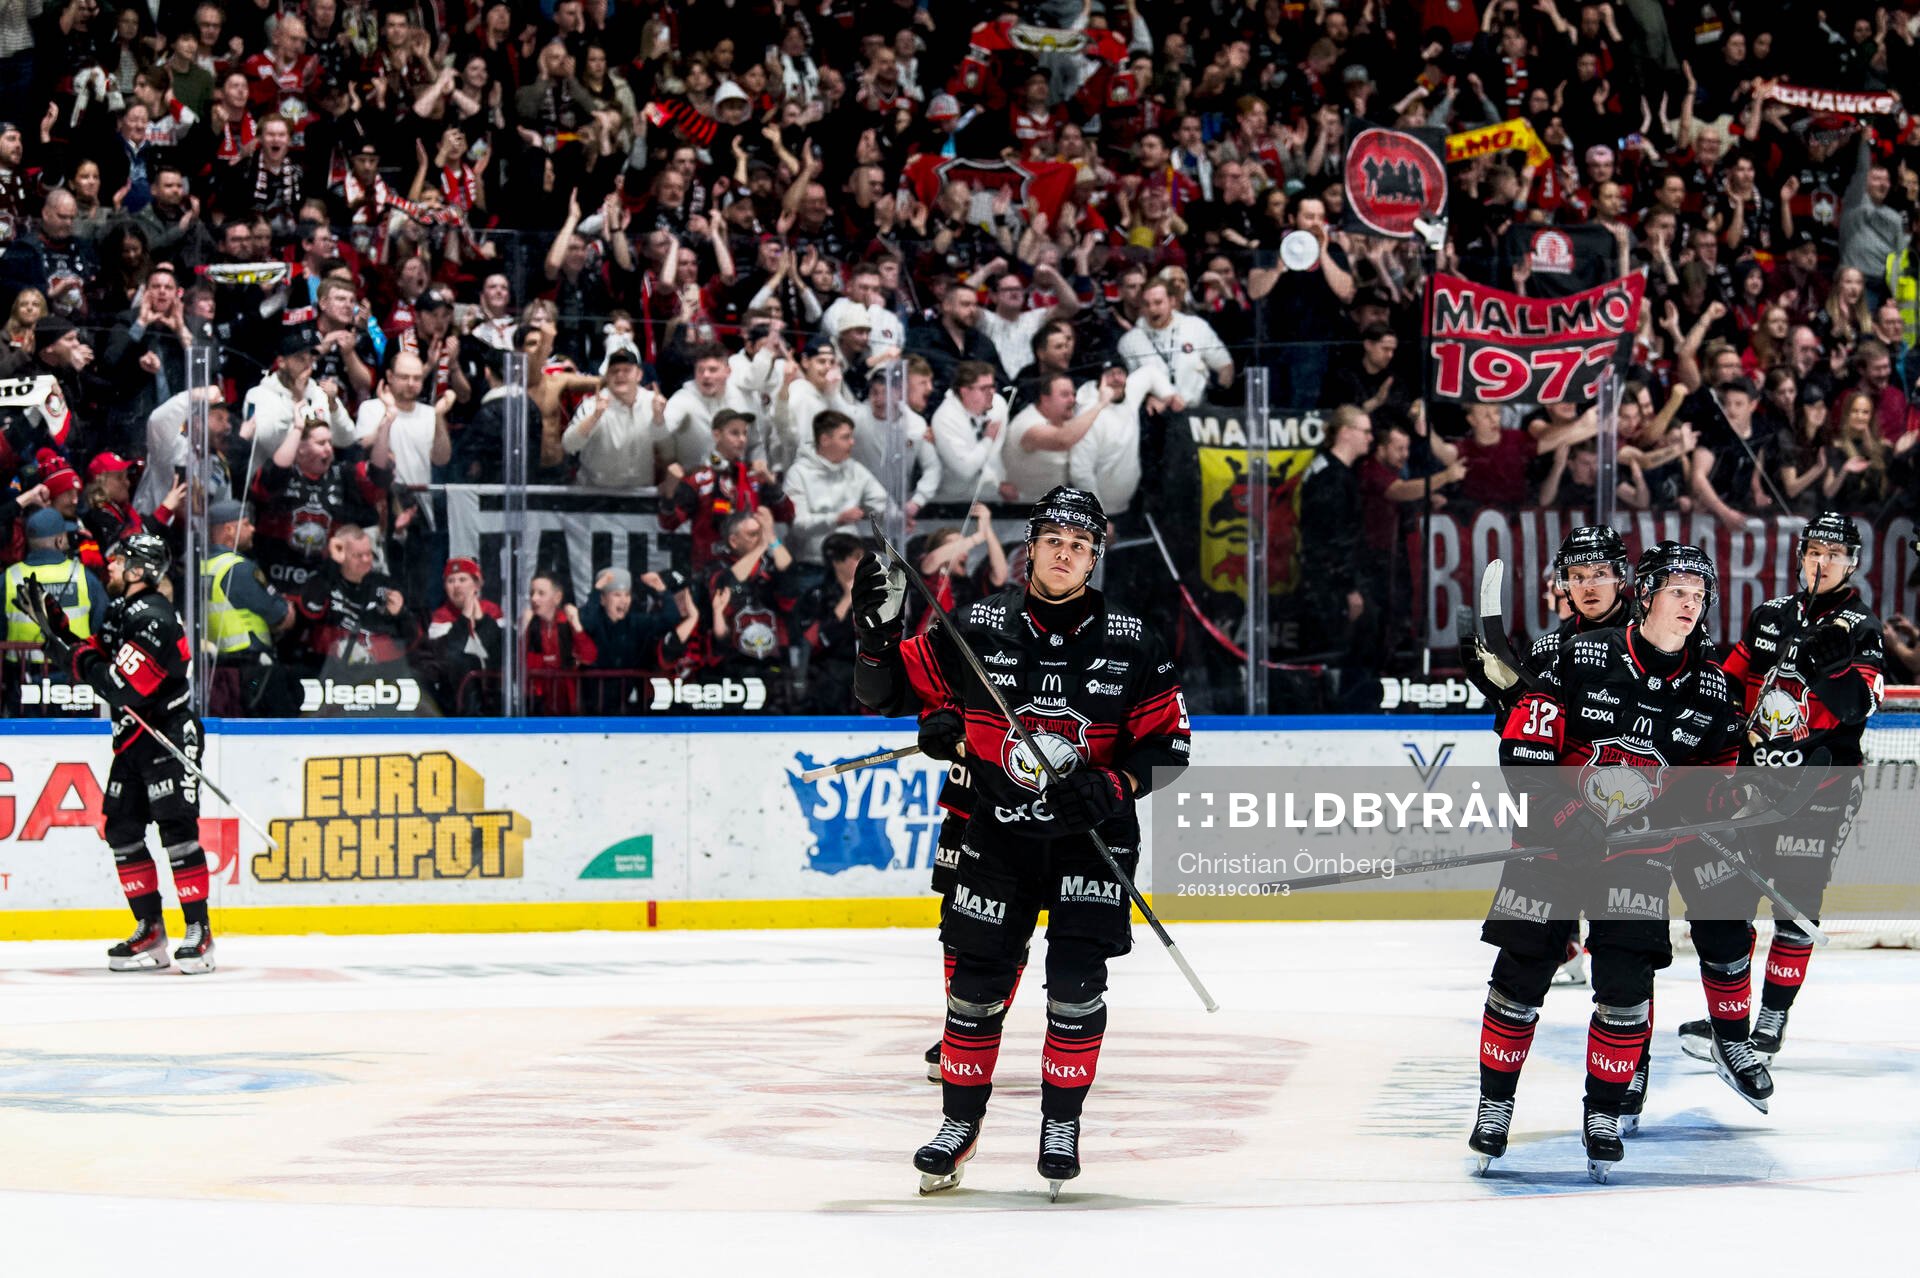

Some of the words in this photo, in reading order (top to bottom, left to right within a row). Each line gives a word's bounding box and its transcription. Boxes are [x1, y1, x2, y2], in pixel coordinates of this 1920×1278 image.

[1771, 84, 1894, 114] DHAWKS
[1432, 282, 1633, 337] MALMÖ
[1188, 411, 1325, 447] MALMÖ
[1046, 508, 1092, 525] BJURFORS
[1809, 529, 1844, 541] BJURFORS
[1564, 552, 1604, 564] BJURFORS
[1673, 558, 1714, 573] BJURFORS
[970, 609, 1005, 623] ARENA
[972, 603, 1007, 615] MALMÖ
[969, 617, 1004, 631] HOTEL
[1107, 621, 1142, 633] ARENA
[1107, 629, 1141, 641] HOTEL
[1531, 645, 1559, 657] HOTEL
[1574, 641, 1609, 651] MALMÖ
[1754, 637, 1777, 652] DOXA
[115, 643, 147, 676] 95
[1574, 649, 1608, 659] ARENA
[1574, 657, 1607, 668] HOTEL
[988, 673, 1018, 687] OXA
[1101, 683, 1124, 691] CHEAP
[1700, 679, 1728, 693] ARENA
[42, 679, 94, 704] isa
[325, 679, 399, 705] isab
[674, 678, 747, 704] isab
[1401, 678, 1467, 703] isab
[1700, 687, 1728, 702] HOTEL
[1033, 696, 1067, 707] MALMÖ
[1523, 699, 1559, 738] 32
[1581, 706, 1615, 724] DOXA
[1513, 747, 1555, 761] tillmobil
[304, 751, 457, 819] EURO
[252, 812, 513, 882] JACKPOT
[1776, 834, 1826, 854] MAXI
[1060, 875, 1122, 901] MAXI
[954, 883, 1007, 919] MAXI
[1071, 896, 1121, 907] STORMARKNAD
[1497, 886, 1552, 919] MAXI
[1607, 887, 1664, 912] MAXI
[957, 907, 1003, 925] STORMARKNAD
[1500, 908, 1548, 925] STORMARKNAD
[950, 1018, 978, 1028] BAUER
[1055, 1021, 1083, 1031] BAUER
[1483, 1041, 1527, 1063] SÄKRA
[1591, 1051, 1635, 1073] SÄKRA
